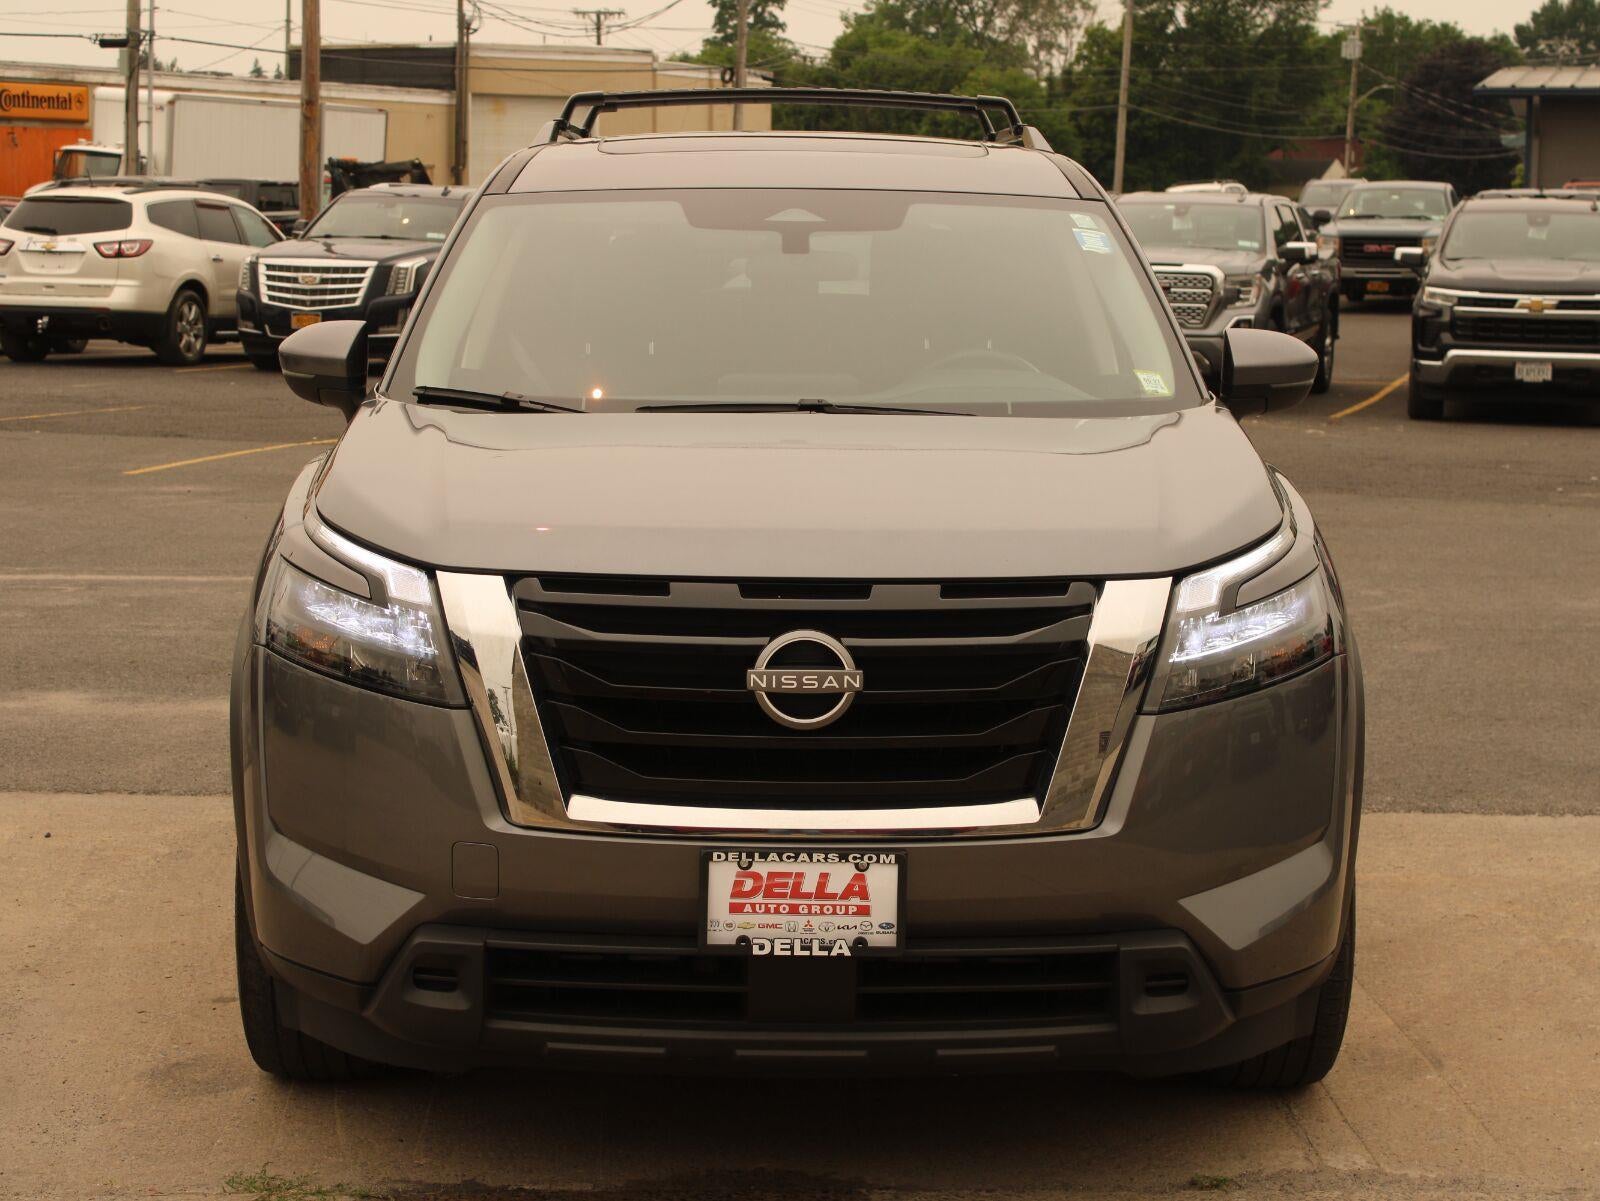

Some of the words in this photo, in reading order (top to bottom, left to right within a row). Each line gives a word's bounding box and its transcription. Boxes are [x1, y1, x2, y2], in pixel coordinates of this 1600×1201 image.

[0, 88, 72, 111] Continental
[750, 674, 860, 689] NISSAN
[712, 851, 896, 864] DELLACARS.COM
[729, 871, 872, 902] DELLA
[743, 903, 790, 914] AUTO
[798, 904, 858, 915] GROUP
[752, 937, 852, 957] DELLA
